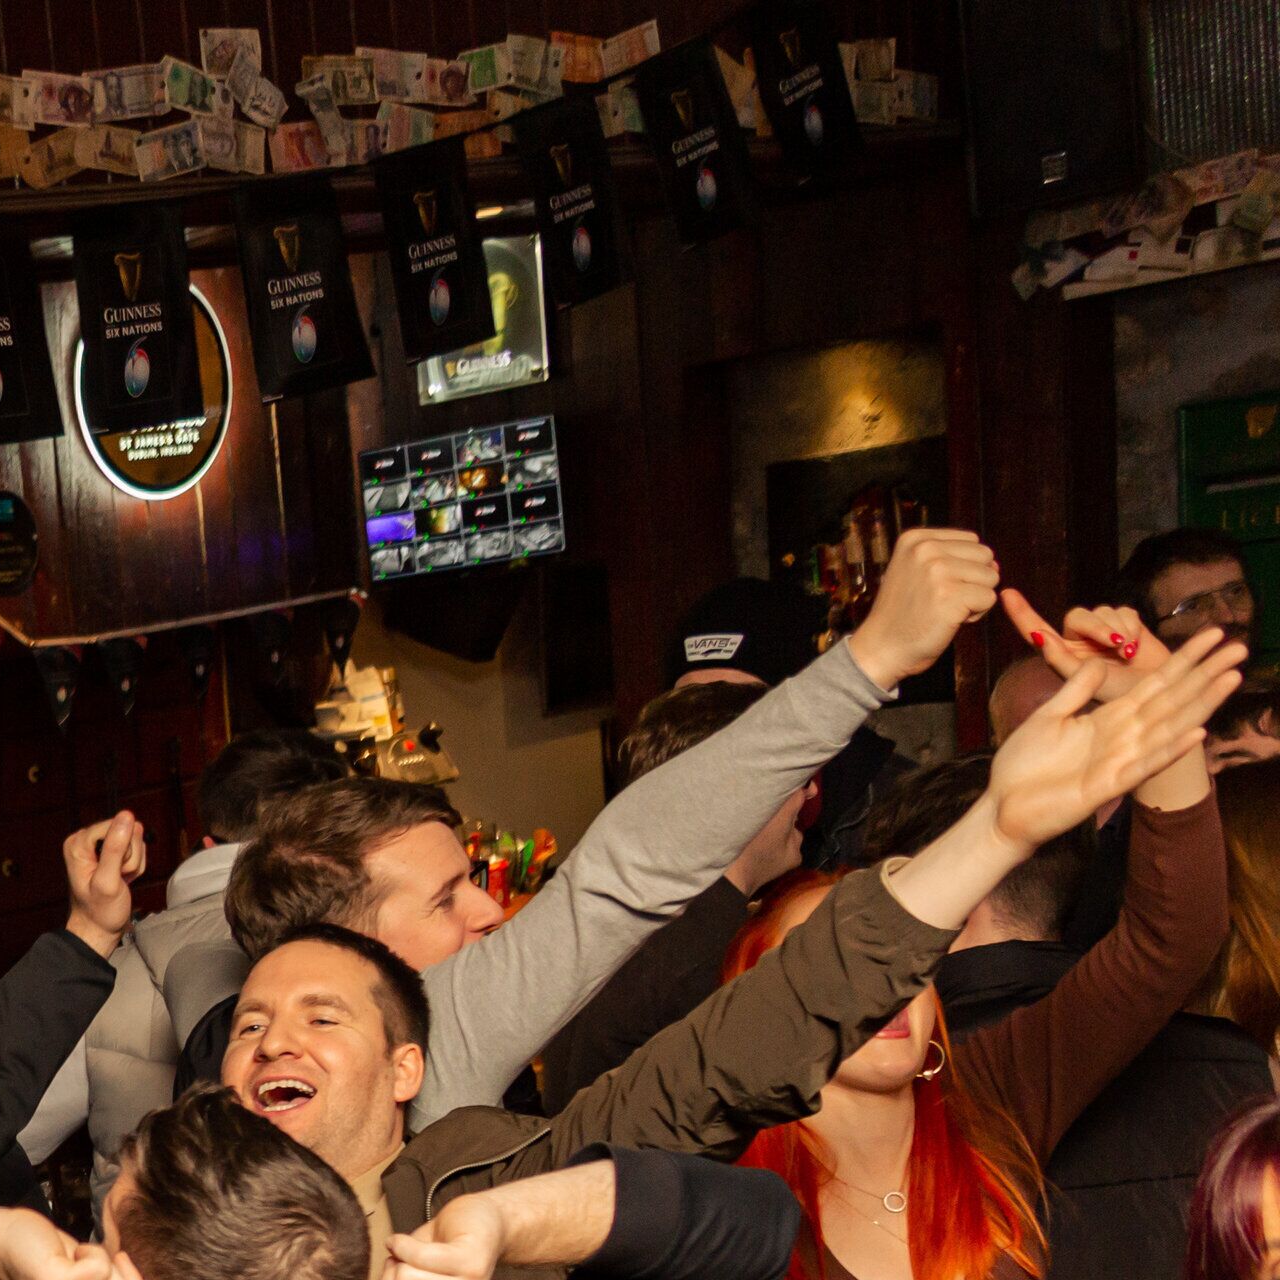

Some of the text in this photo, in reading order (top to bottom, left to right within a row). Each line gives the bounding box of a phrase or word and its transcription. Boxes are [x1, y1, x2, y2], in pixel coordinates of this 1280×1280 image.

[408, 233, 457, 260] GUINNESS
[411, 251, 459, 275] SIX NATIONS
[267, 270, 323, 296] GUINNESS
[271, 287, 325, 311] SIX NATIONS
[103, 302, 162, 325] GUINNESS
[105, 321, 164, 341] SIX NATIONS
[694, 638, 731, 649] VANS
